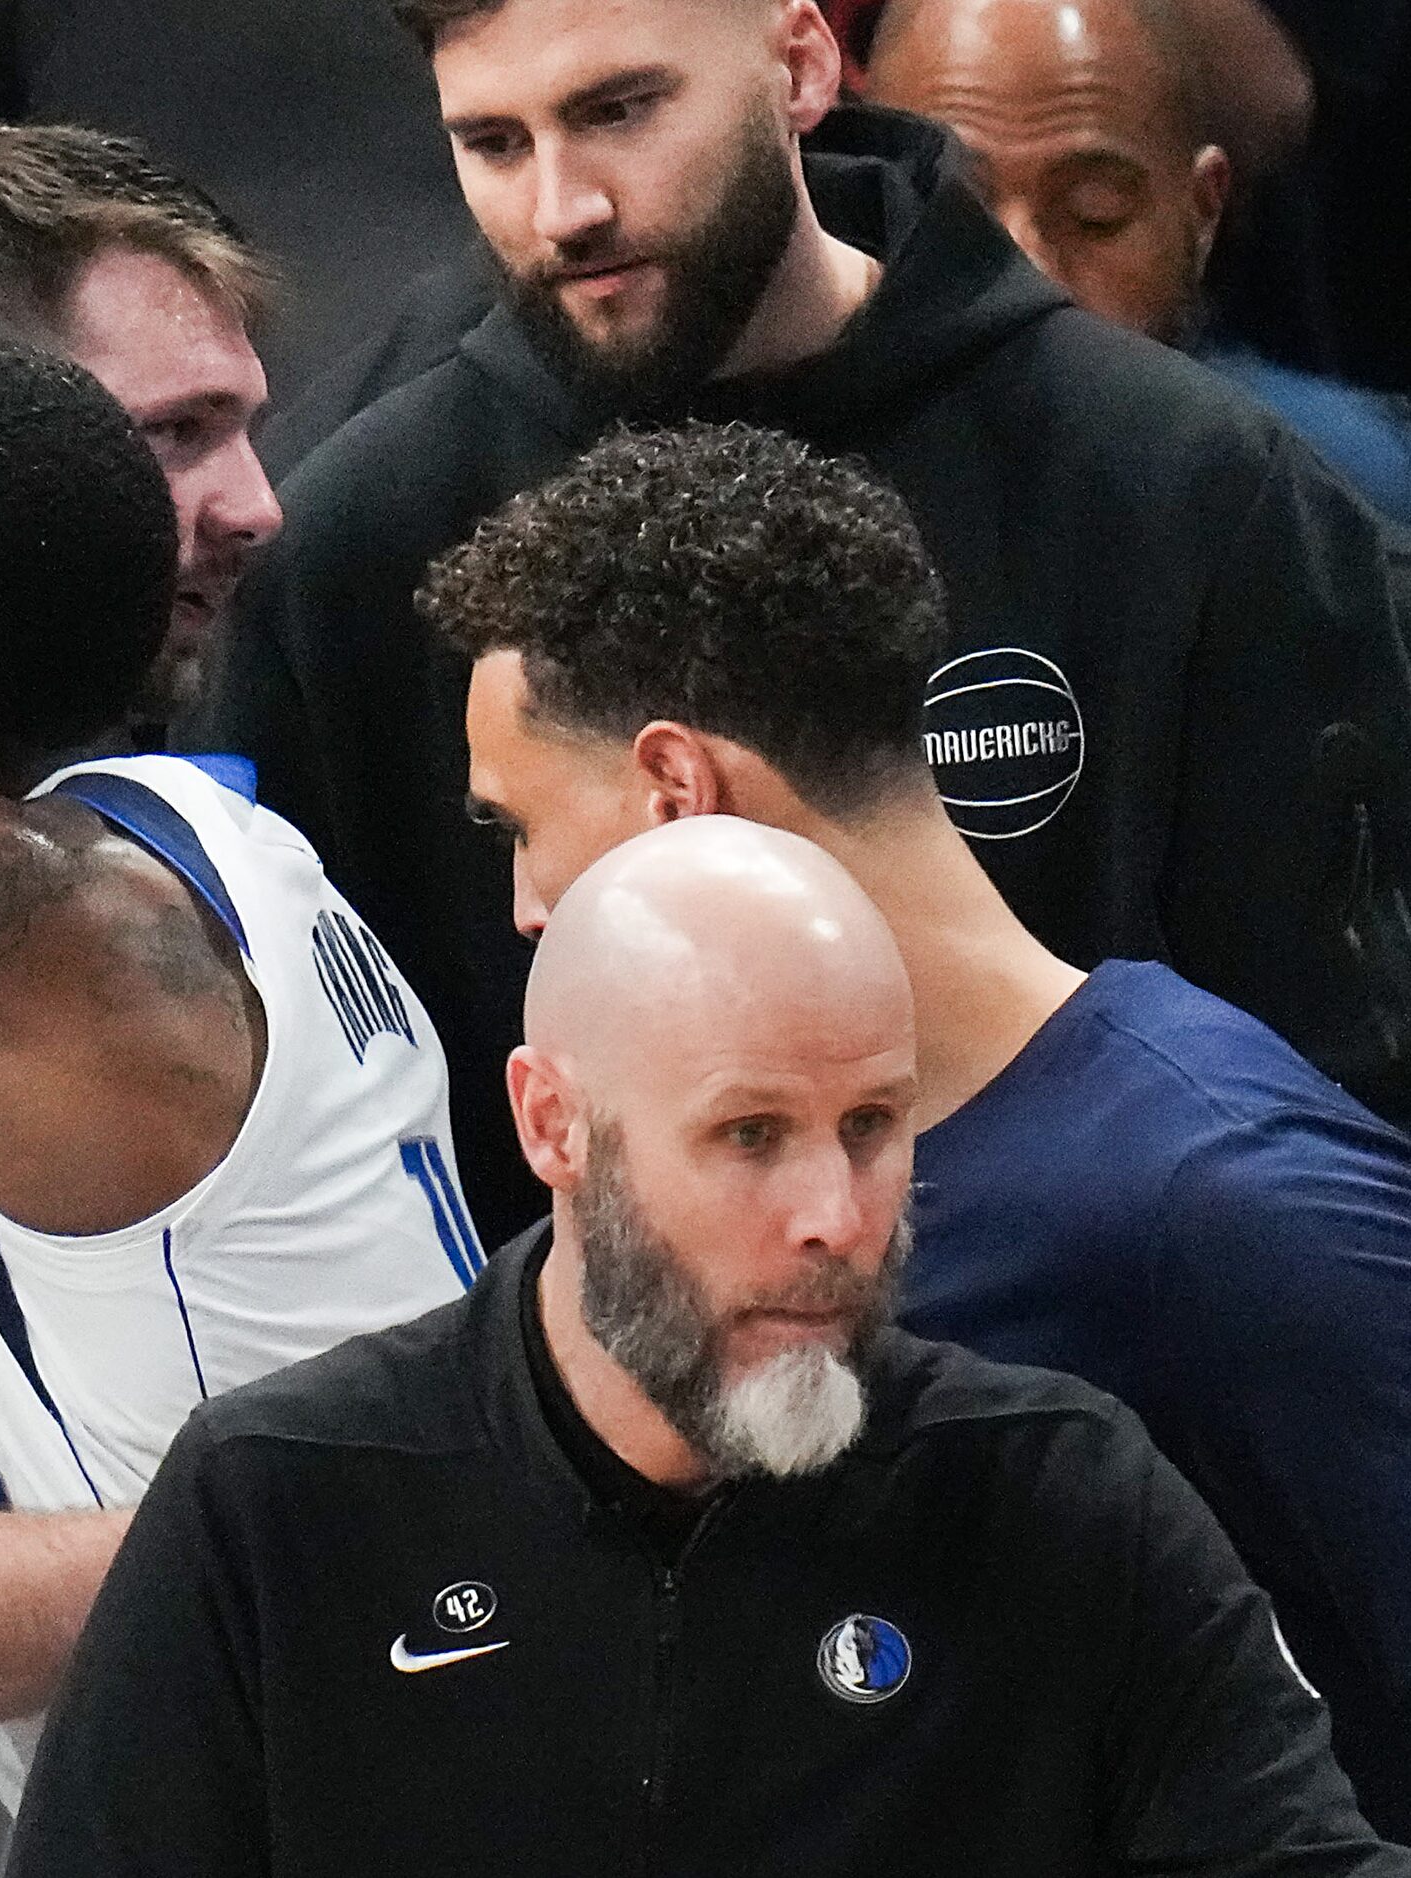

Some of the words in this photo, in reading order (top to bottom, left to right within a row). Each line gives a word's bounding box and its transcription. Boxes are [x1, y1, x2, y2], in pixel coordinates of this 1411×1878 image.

[923, 719, 1070, 766] MAVERICKS
[397, 1135, 485, 1292] 11
[446, 1588, 485, 1623] 42
